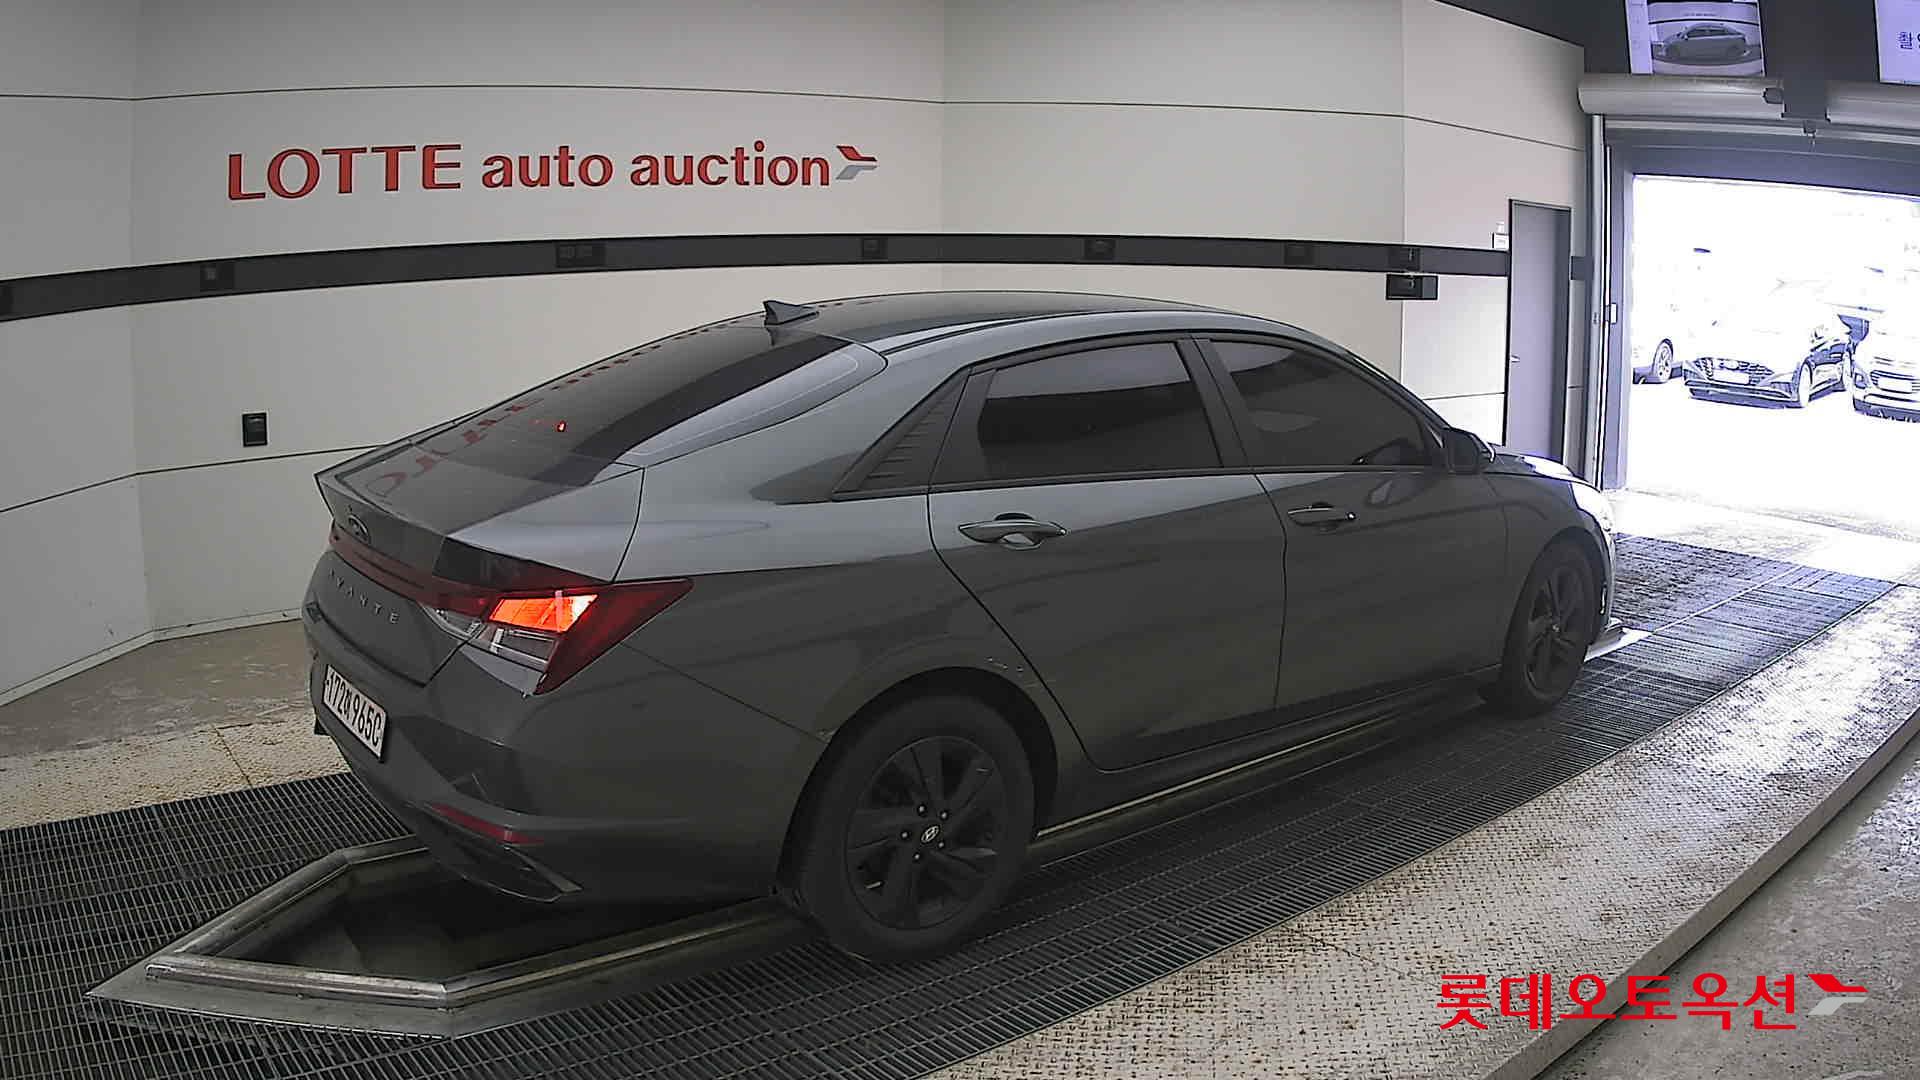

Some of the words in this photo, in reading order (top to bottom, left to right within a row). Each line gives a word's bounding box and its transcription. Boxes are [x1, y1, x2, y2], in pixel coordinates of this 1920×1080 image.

[228, 144, 462, 200] LOTTE
[482, 147, 614, 187] auto
[631, 140, 831, 186] auction
